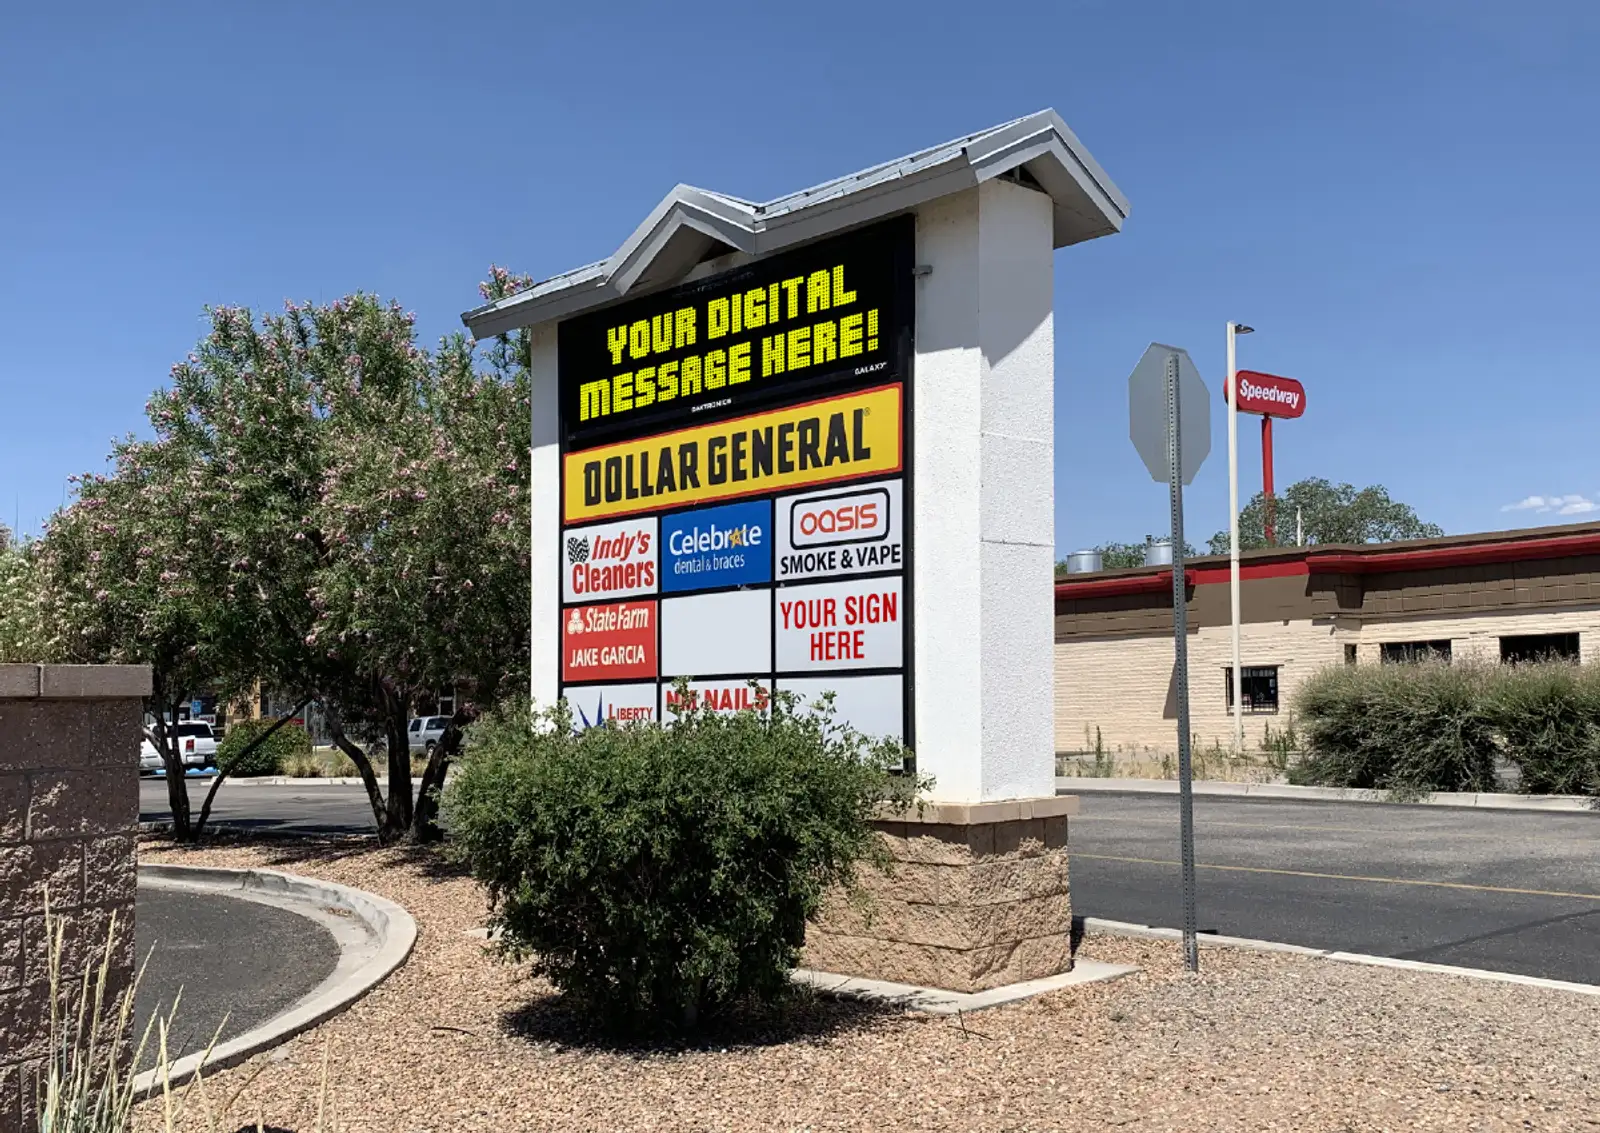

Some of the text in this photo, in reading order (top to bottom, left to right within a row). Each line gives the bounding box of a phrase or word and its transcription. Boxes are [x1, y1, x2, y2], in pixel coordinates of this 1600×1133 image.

[607, 264, 857, 365] YOUR DIGITAL
[580, 308, 879, 422] MESSAGE HERE!
[1240, 379, 1300, 409] Speedway
[584, 440, 701, 507] DOLLAR
[592, 530, 651, 562] Indy's
[780, 543, 901, 575] SMOKE & VAPE
[572, 560, 655, 595] Cleaners
[674, 553, 745, 575] dental & braces
[780, 592, 897, 630] YOUR SIGN
[569, 645, 645, 668] JAKE GARCIA
[810, 630, 865, 661] HERE
[704, 686, 769, 712] NAILS
